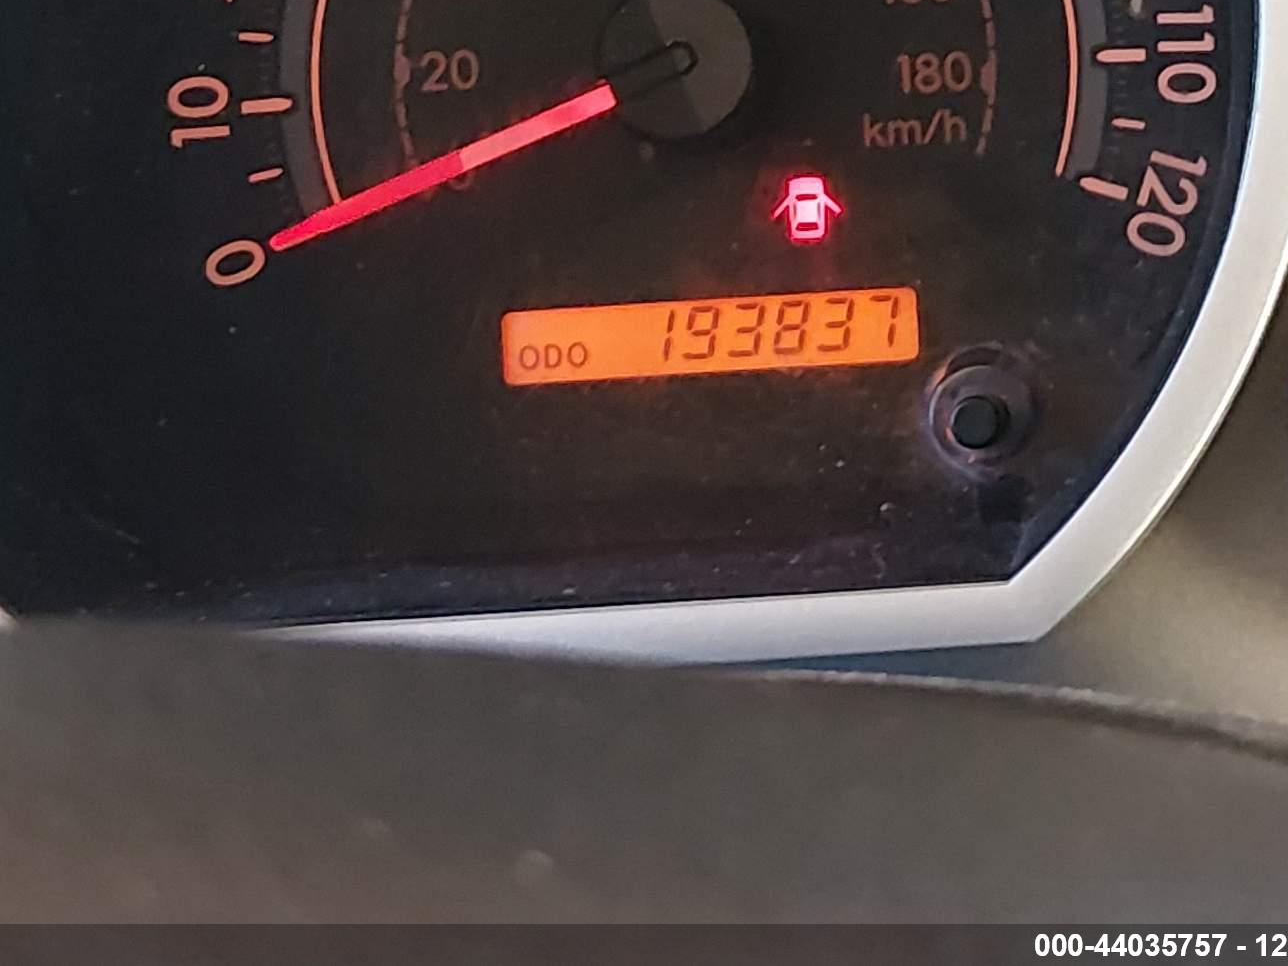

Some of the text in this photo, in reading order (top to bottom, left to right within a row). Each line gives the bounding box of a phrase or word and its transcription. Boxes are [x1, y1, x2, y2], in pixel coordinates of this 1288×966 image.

[419, 49, 479, 92] 20
[896, 51, 972, 94] 180
[1156, 4, 1217, 104] 110
[167, 76, 231, 148] 10
[862, 109, 967, 148] km/h
[1125, 150, 1207, 257] 120
[205, 239, 266, 286] 0
[519, 294, 900, 370] ODO 193837
